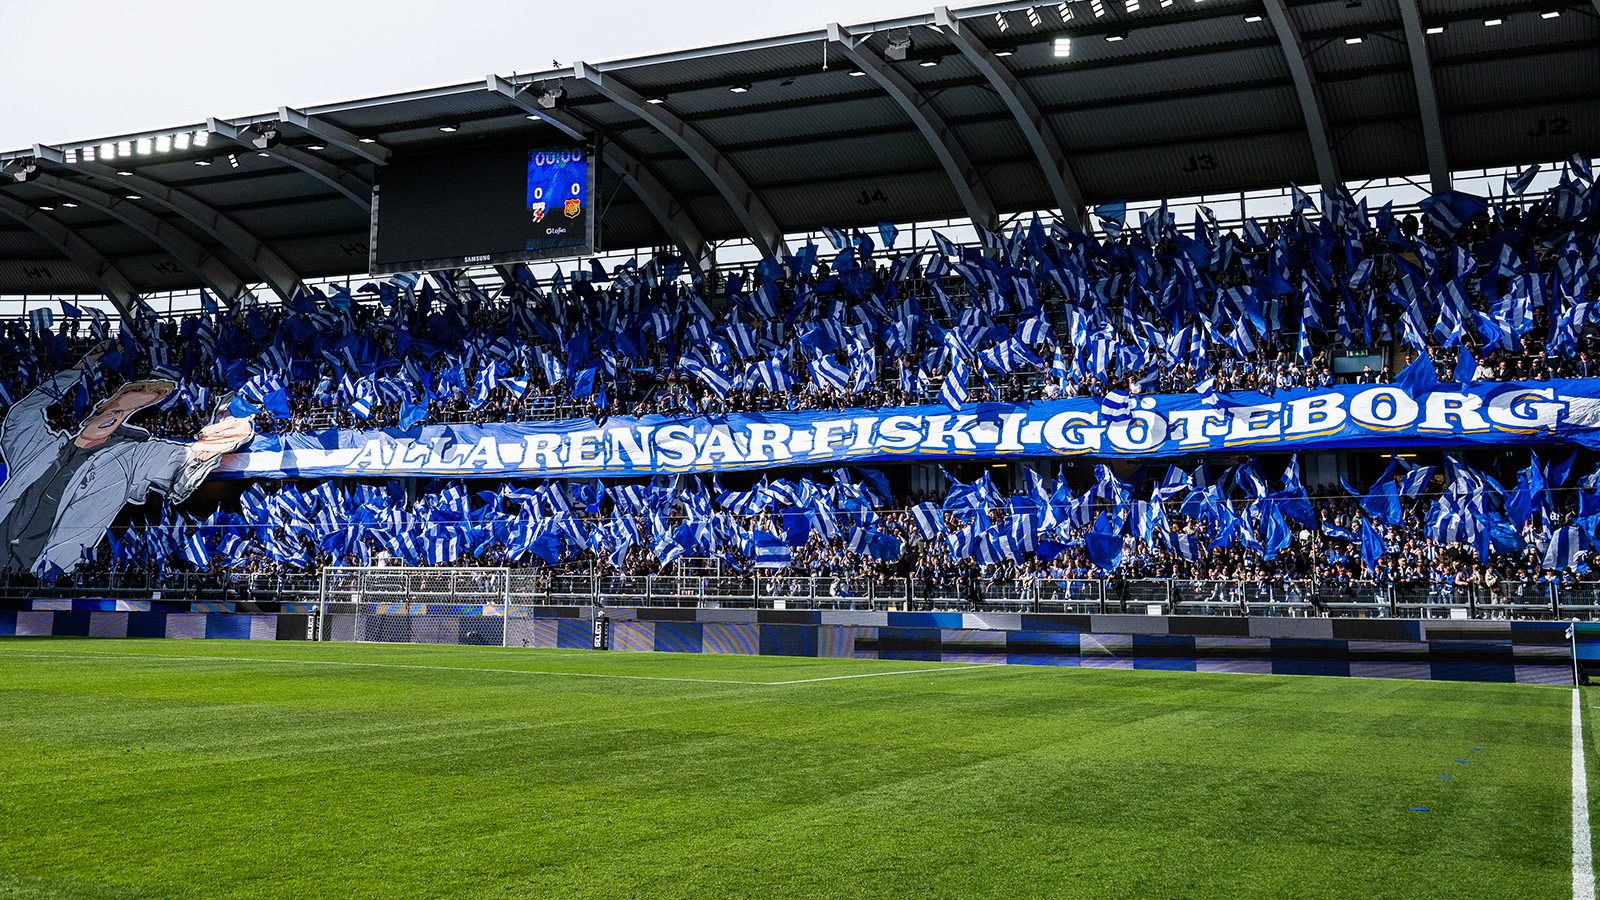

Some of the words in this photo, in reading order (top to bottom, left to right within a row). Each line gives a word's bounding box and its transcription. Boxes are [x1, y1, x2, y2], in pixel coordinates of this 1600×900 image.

[1526, 117, 1570, 137] J2
[1181, 154, 1217, 173] J3
[534, 187, 543, 199] 0
[571, 183, 580, 195] 0
[856, 188, 888, 205] J4
[464, 254, 491, 263] SAMSUNG
[23, 266, 52, 279] H1
[151, 261, 184, 275] H2
[343, 435, 504, 474] ALLA
[516, 422, 795, 472] RENSAR
[807, 410, 980, 459] FISK
[995, 411, 1027, 454] I
[1045, 386, 1571, 455] GÖTEBORG
[594, 621, 602, 648] SELECT
